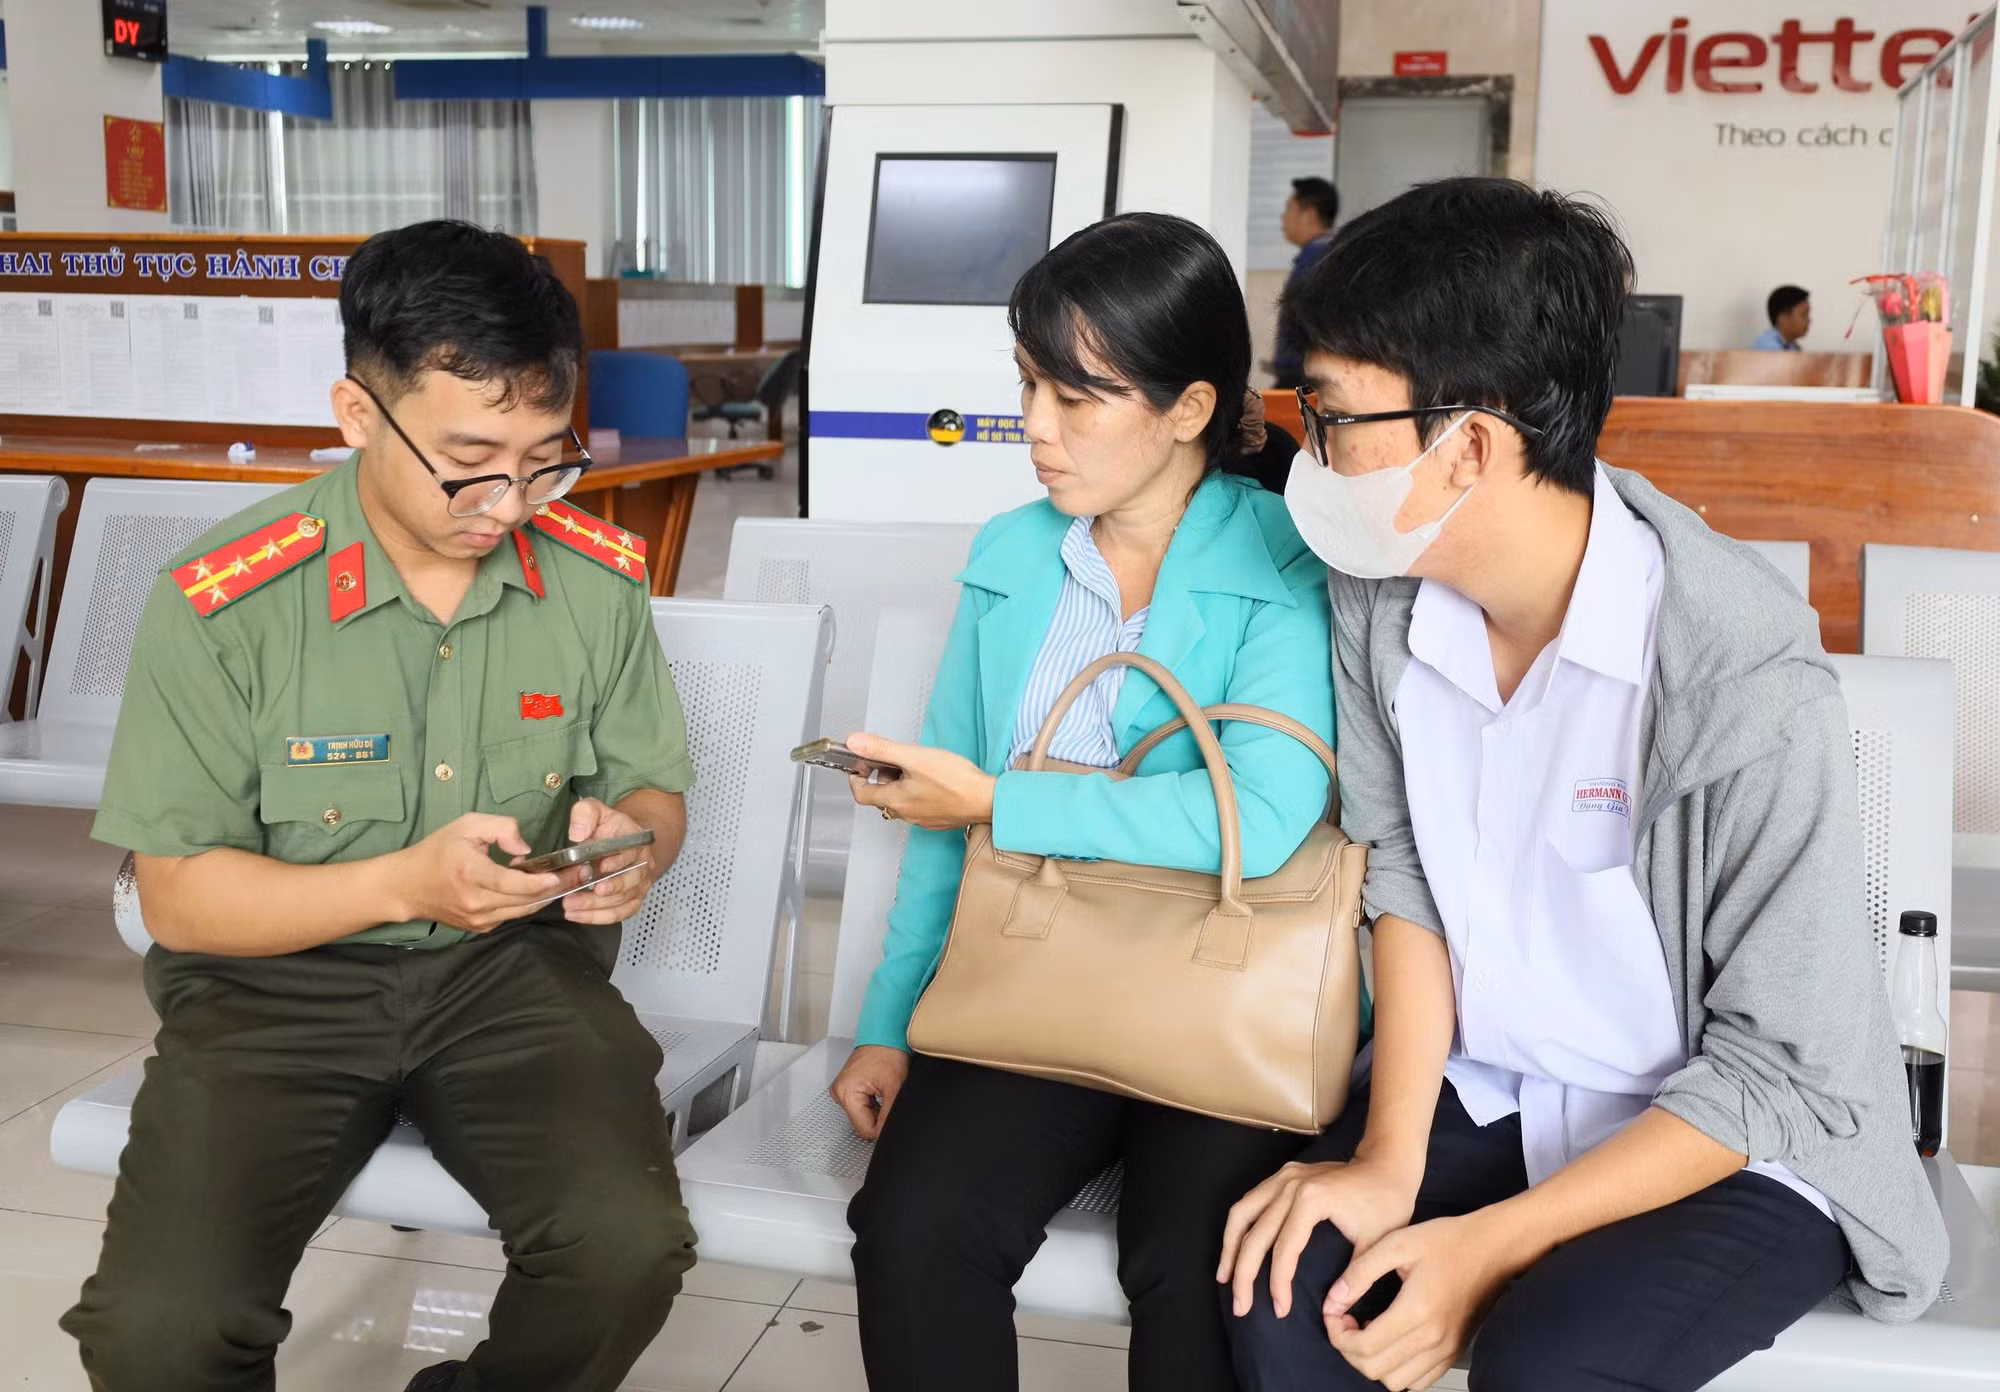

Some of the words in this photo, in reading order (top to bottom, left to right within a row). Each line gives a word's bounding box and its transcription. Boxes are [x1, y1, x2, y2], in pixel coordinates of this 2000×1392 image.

[114, 18, 140, 46] DY
[1587, 13, 1980, 95] viette
[1714, 123, 1786, 147] Theo
[1797, 123, 1868, 147] cách
[0, 252, 52, 276] HAI
[61, 246, 125, 277] THỦ
[134, 252, 197, 282] TỤC
[206, 248, 301, 280] HÀNH
[327, 752, 346, 760] 524
[355, 751, 374, 759] 881
[1576, 788, 1622, 800] HERMANN
